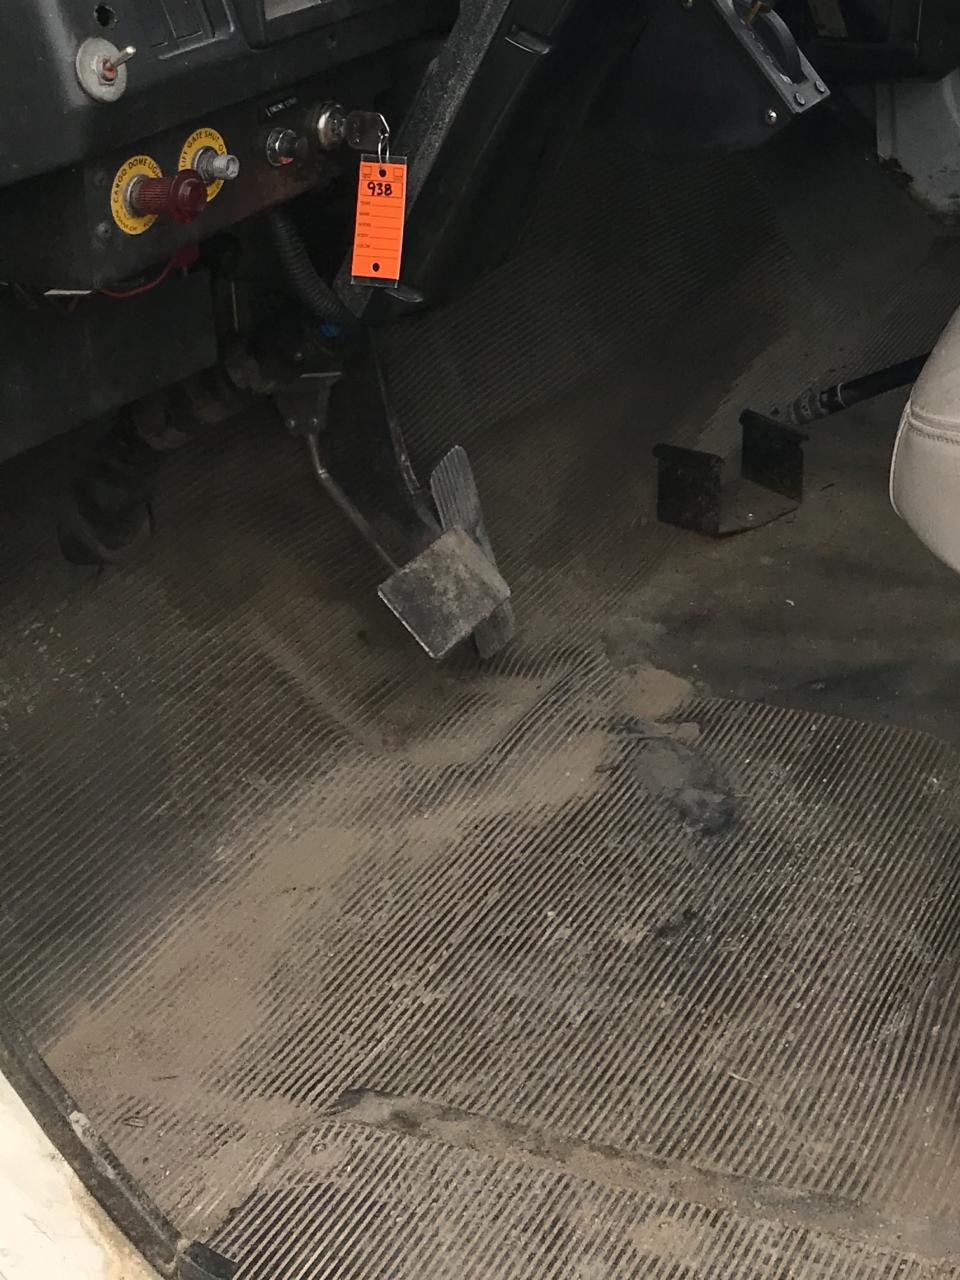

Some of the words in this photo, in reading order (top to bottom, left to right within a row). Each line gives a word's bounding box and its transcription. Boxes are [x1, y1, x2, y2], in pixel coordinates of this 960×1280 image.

[188, 131, 203, 148] GATE
[112, 169, 128, 203] CARGO
[128, 158, 147, 169] DOME
[368, 182, 392, 196] 938
